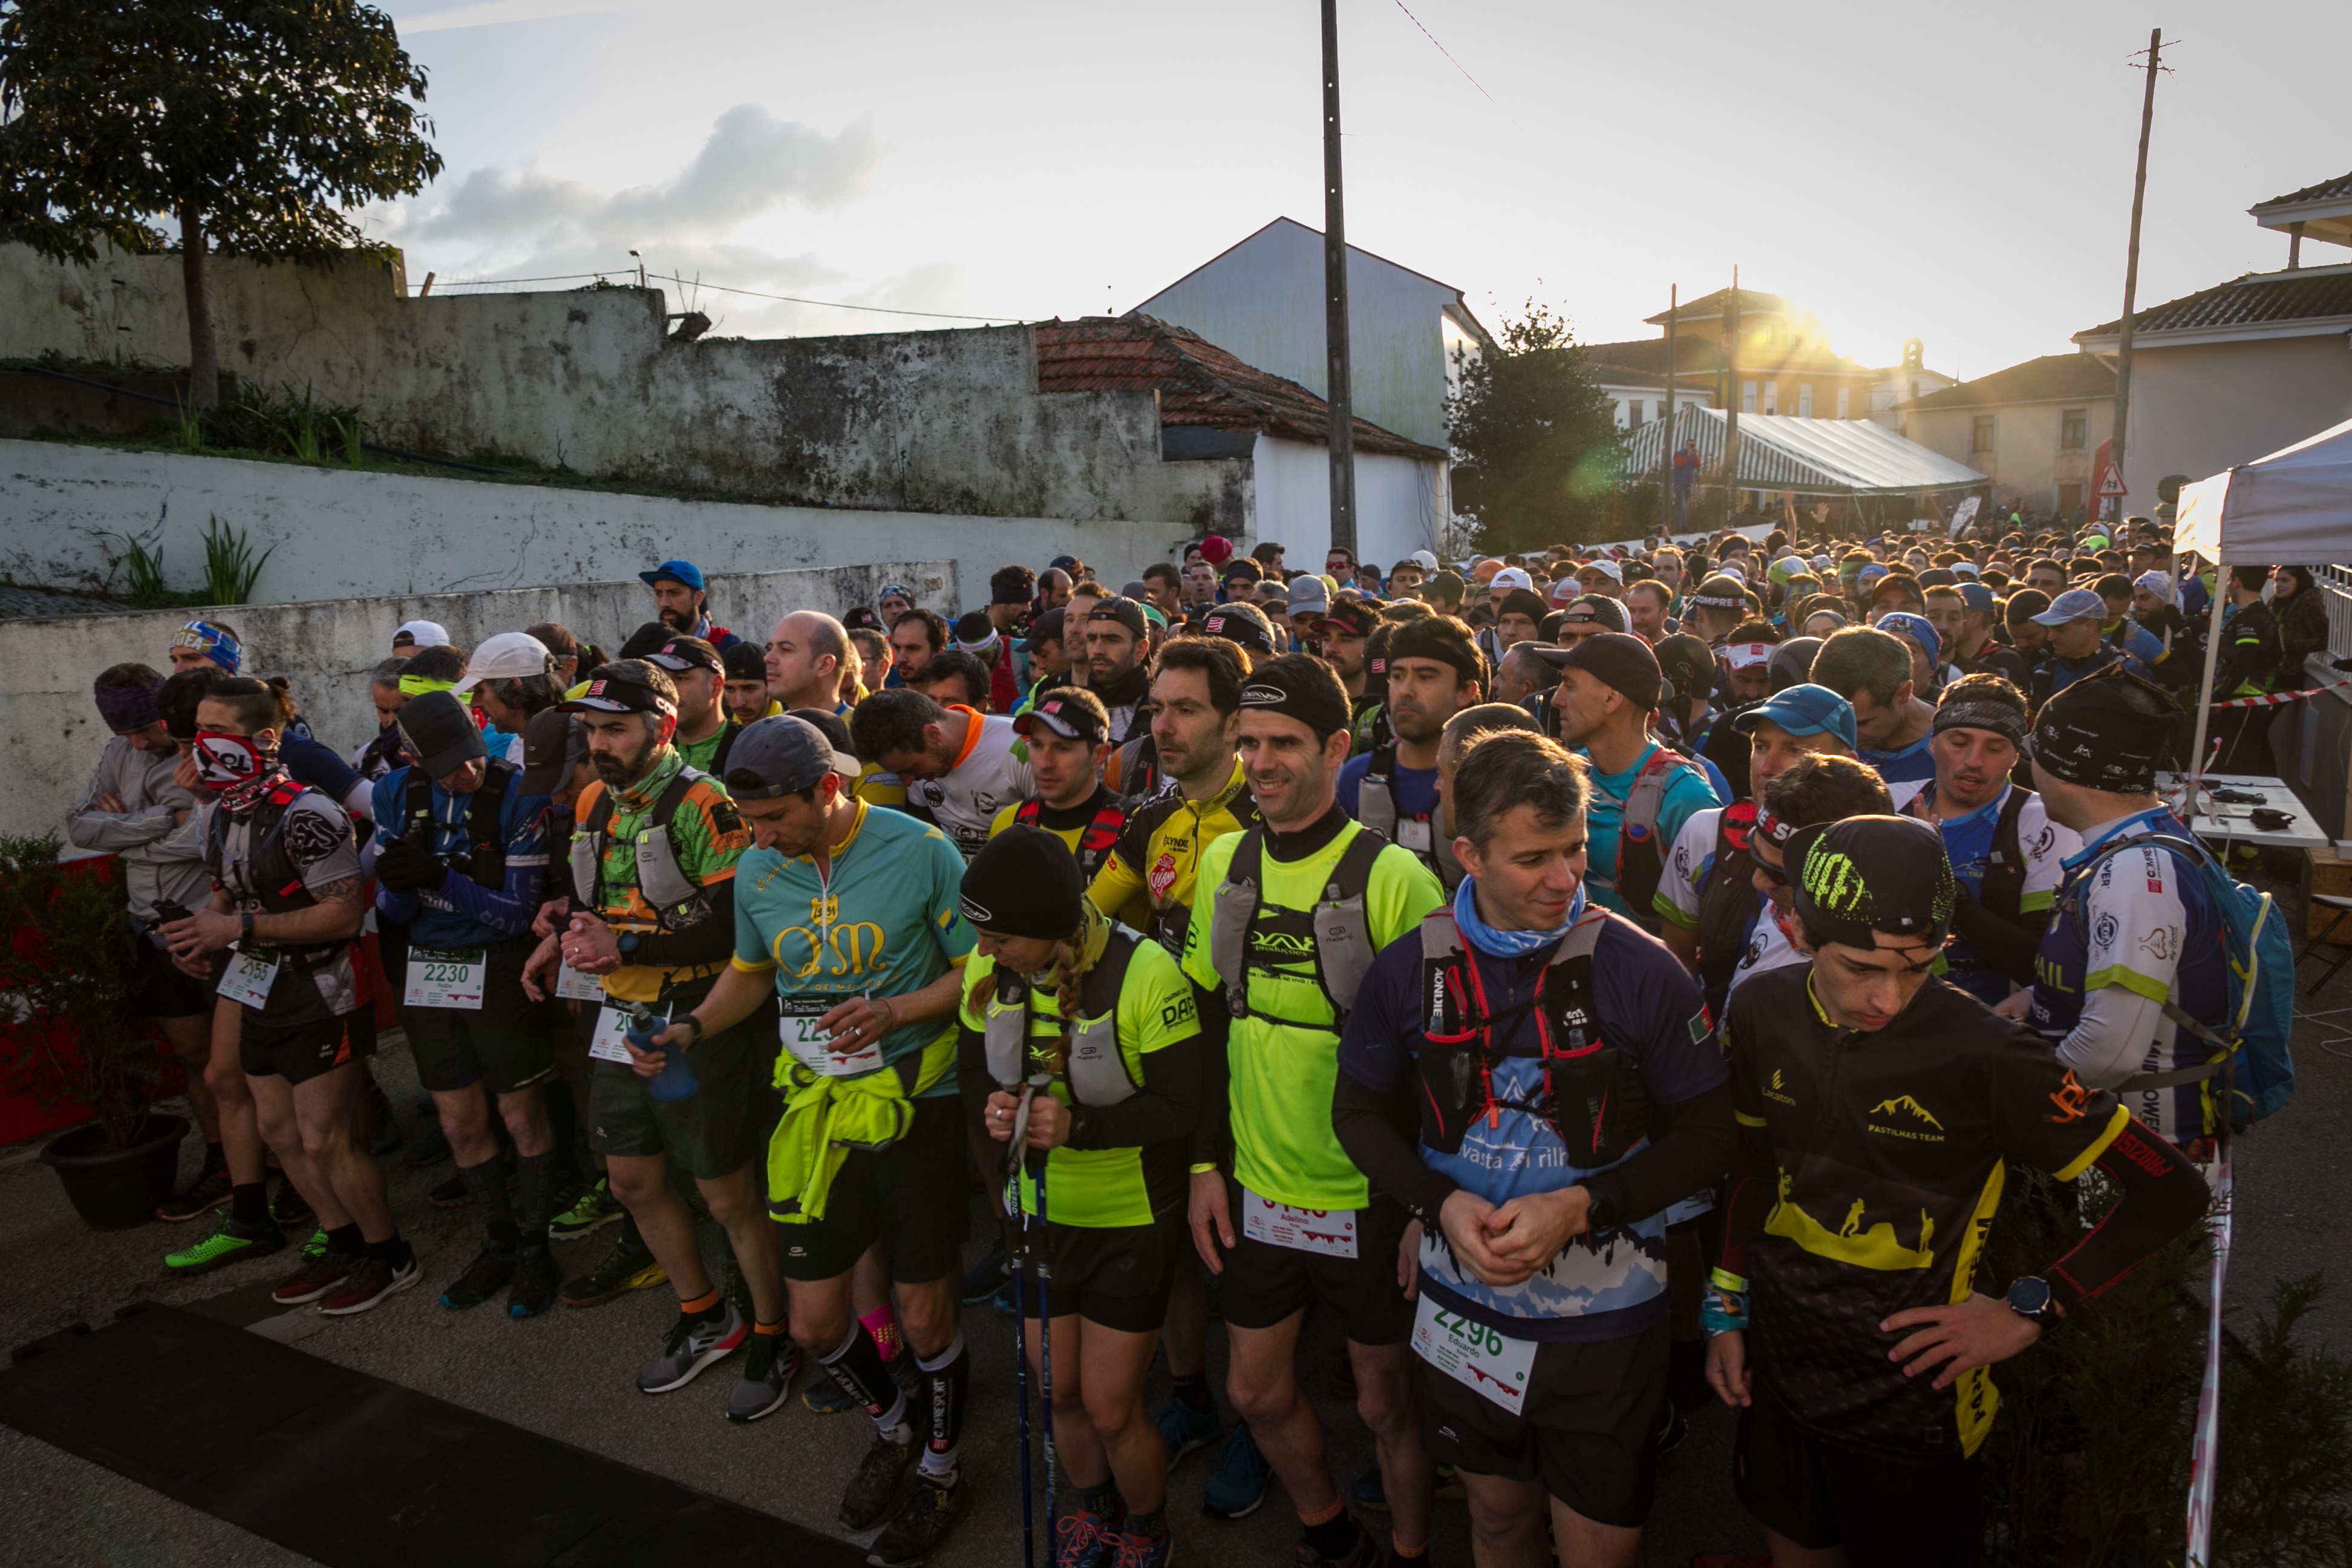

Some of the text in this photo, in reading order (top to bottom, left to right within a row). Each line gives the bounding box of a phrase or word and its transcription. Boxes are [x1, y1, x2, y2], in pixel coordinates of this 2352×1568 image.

[424, 964, 469, 982] 2230
[1763, 1086, 1796, 1106] Lacatoni
[1869, 1123, 1945, 1142] PASTILHAS TEAM
[1459, 1144, 1503, 1170] vasta
[1281, 1214, 1309, 1225] Adelino
[1434, 1309, 1503, 1357] 2296
[1448, 1333, 1480, 1359] Eduardo
